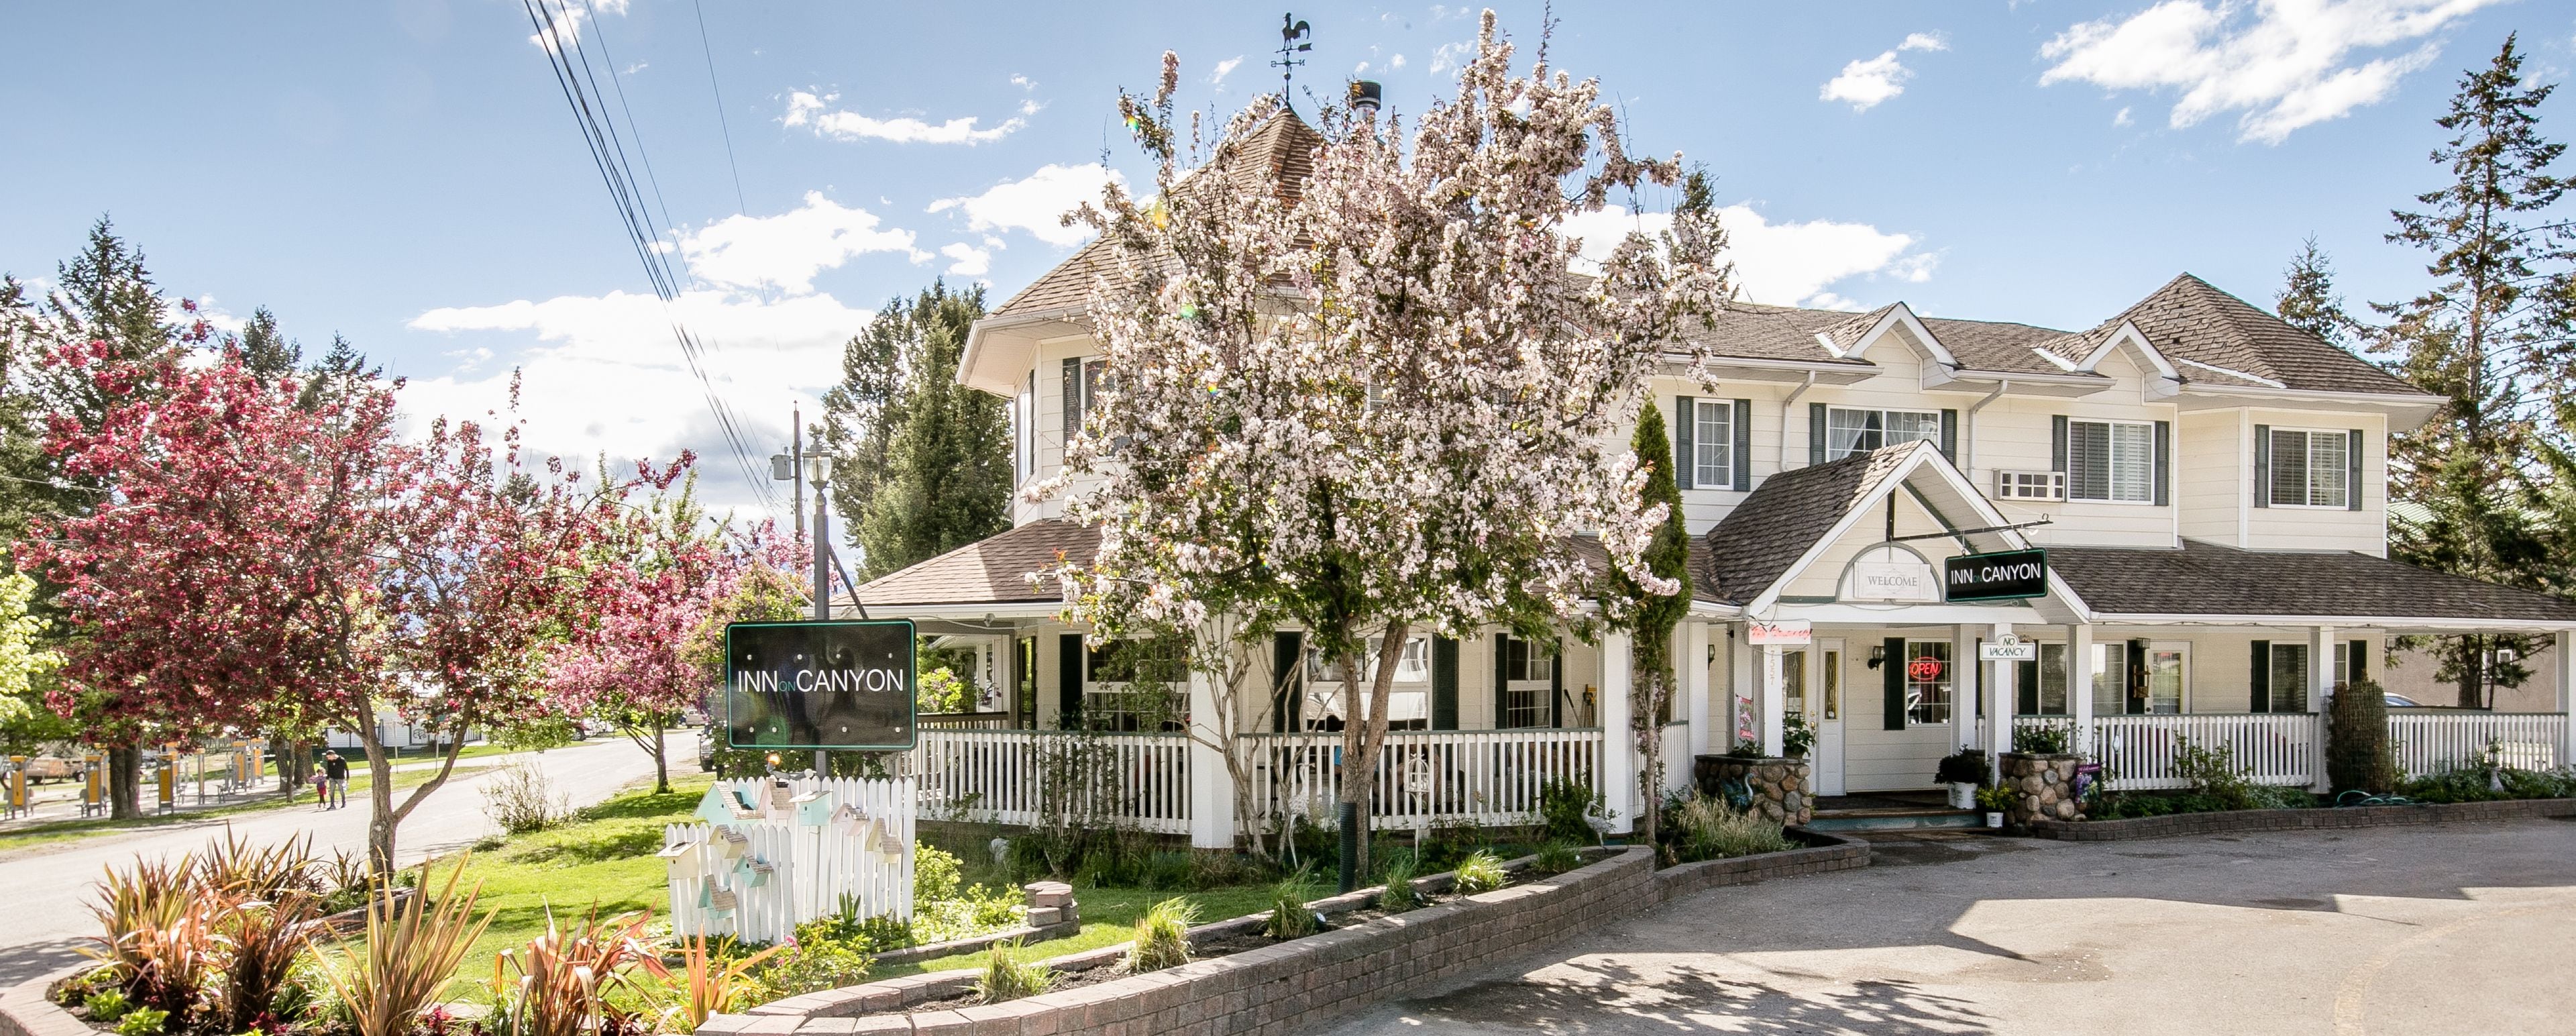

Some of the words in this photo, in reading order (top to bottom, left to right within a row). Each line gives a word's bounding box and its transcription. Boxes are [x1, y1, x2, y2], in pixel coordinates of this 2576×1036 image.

[1951, 568, 1973, 585] INN
[1982, 562, 2041, 583] CANYON
[1868, 576, 1917, 586] WELCOME
[2002, 637, 2015, 646] NO
[1989, 647, 2026, 656] VACANCY
[1911, 662, 1939, 675] OPEN
[738, 670, 777, 692] INN
[779, 680, 796, 692] ON
[796, 668, 904, 692] CANYON
